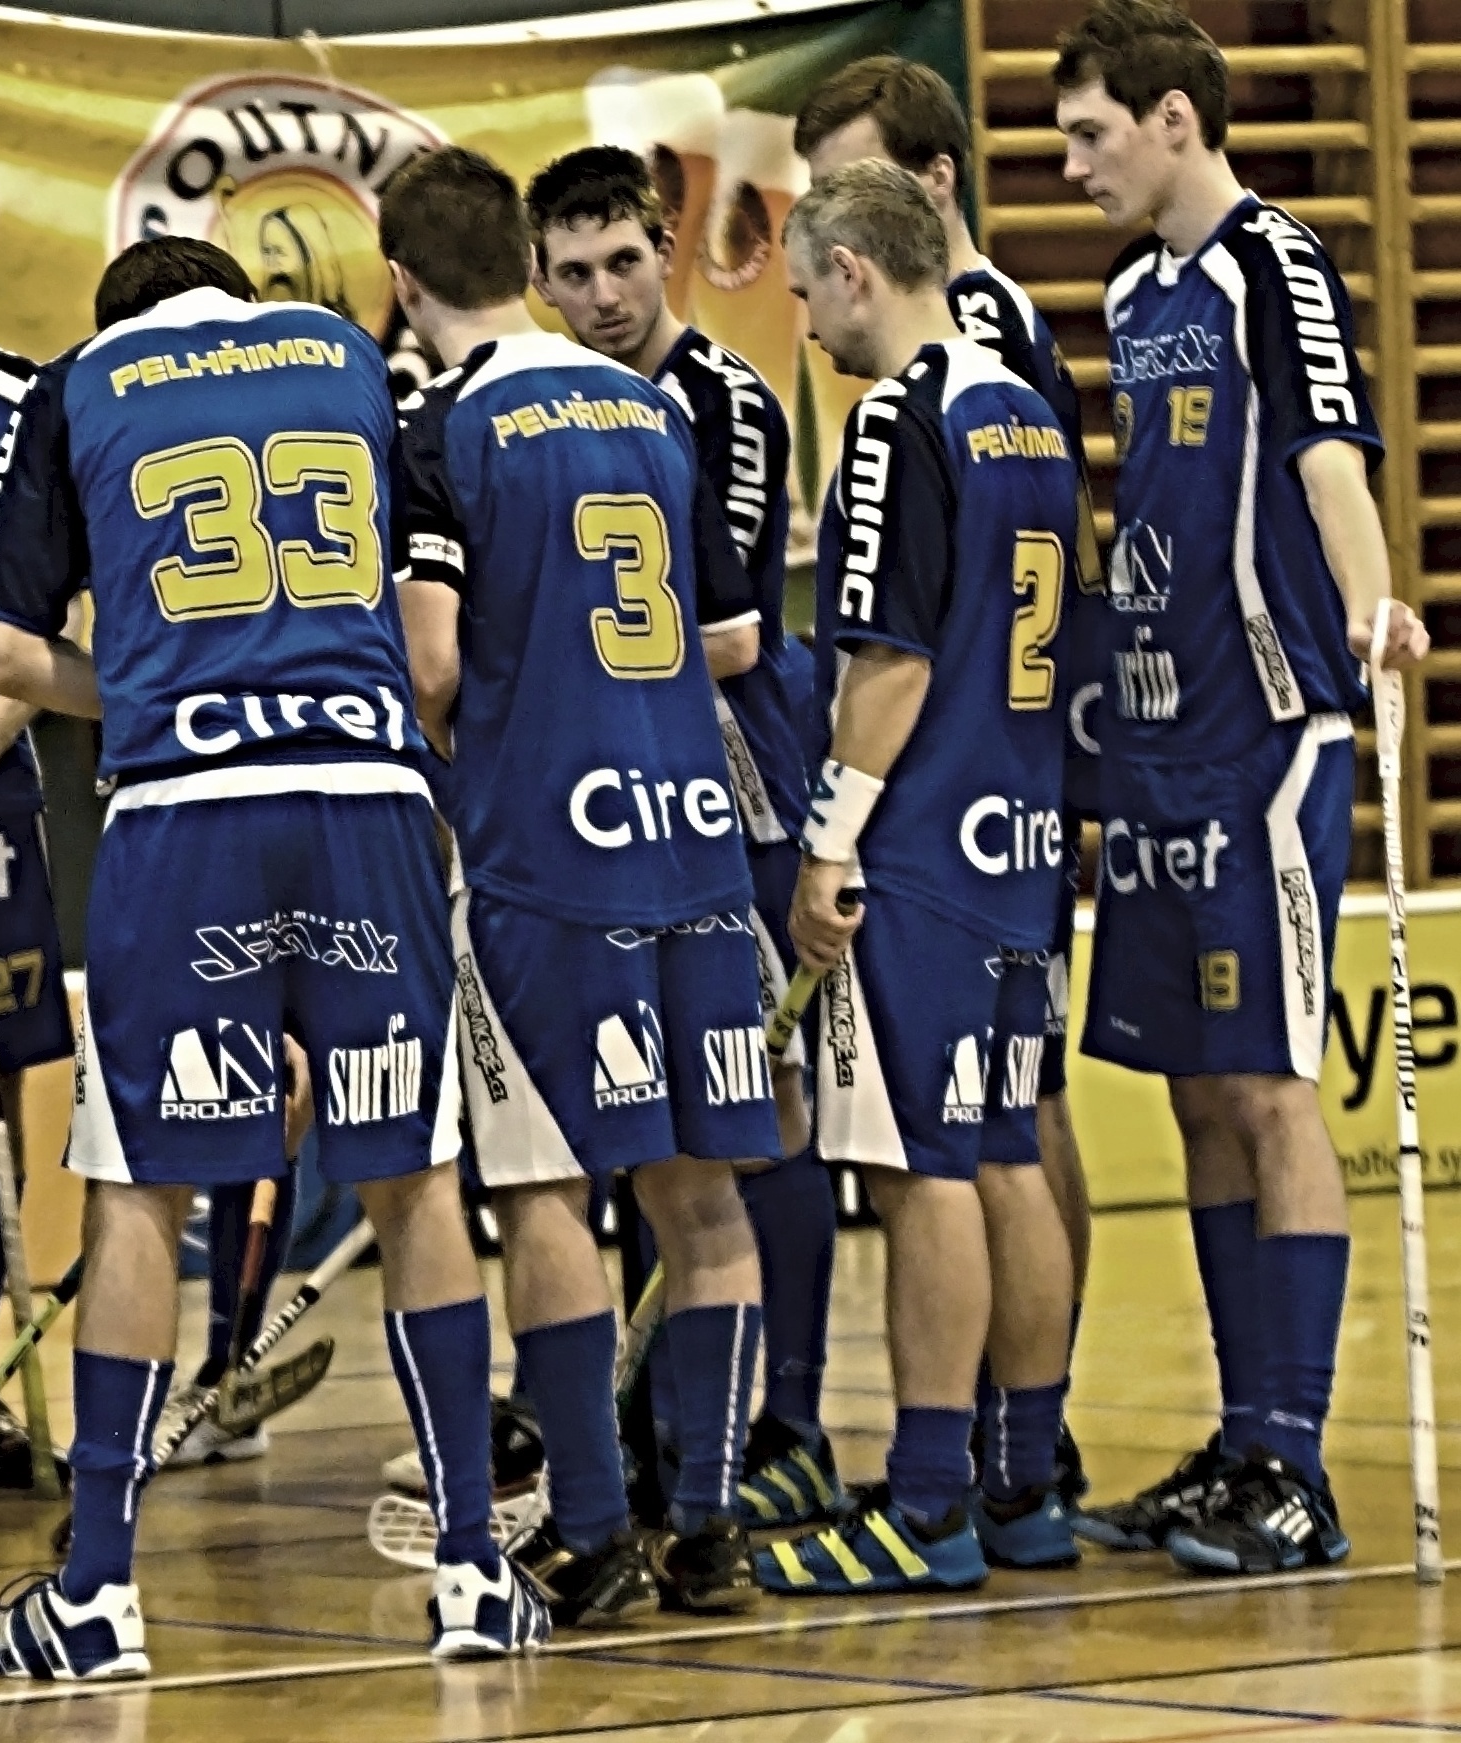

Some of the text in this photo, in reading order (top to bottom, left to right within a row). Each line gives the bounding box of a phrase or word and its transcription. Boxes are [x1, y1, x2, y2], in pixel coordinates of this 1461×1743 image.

[141, 100, 433, 242] OUTN
[109, 338, 348, 397] PELHŘIMOV
[1242, 209, 1358, 426] SALMING
[490, 391, 669, 449] PELHŘIMOV
[131, 431, 383, 623] 33
[572, 492, 687, 681] 3
[1007, 529, 1064, 712] 2
[569, 769, 743, 848] Cire
[1104, 816, 1230, 894] Ciret
[160, 1094, 276, 1121] PROJECT
[327, 1013, 423, 1126] surfin
